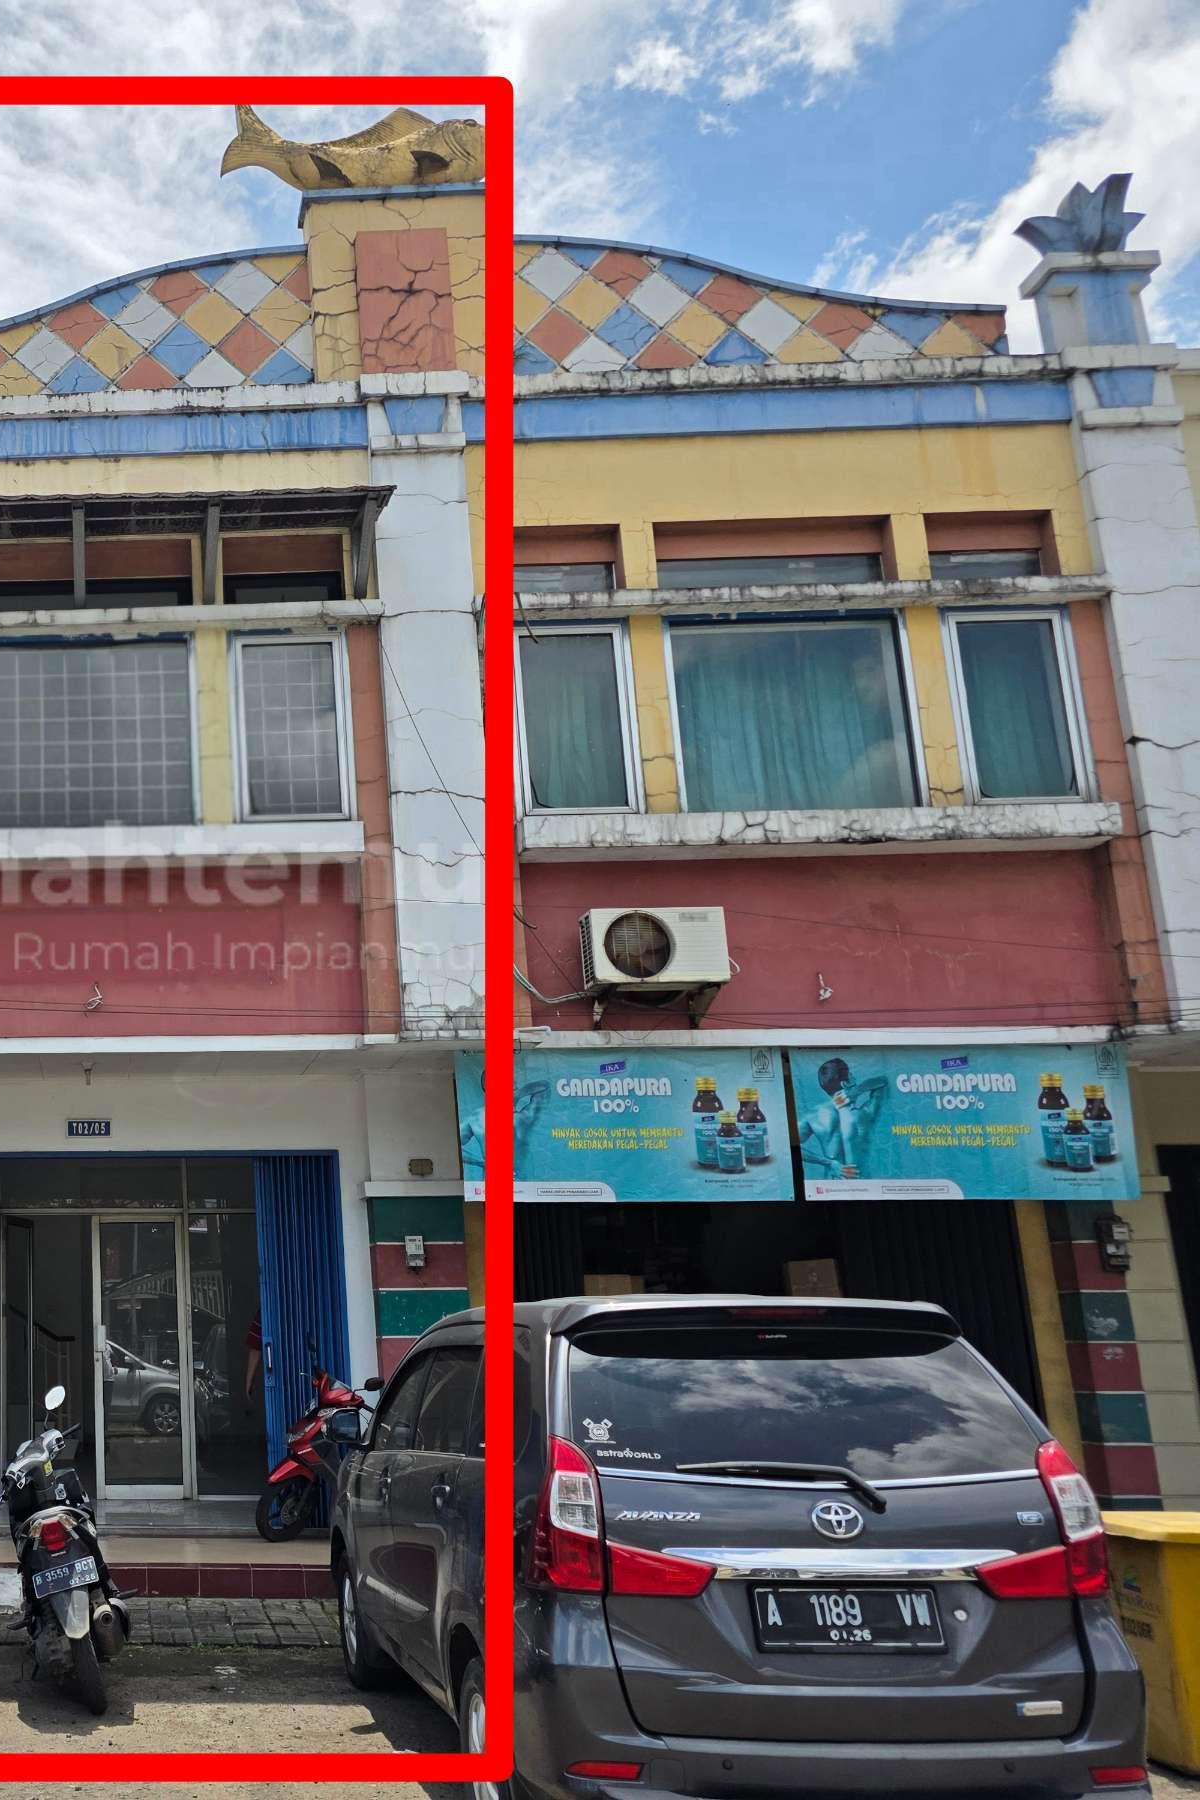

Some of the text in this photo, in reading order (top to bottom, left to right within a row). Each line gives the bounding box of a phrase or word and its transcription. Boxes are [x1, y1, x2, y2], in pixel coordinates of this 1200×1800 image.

[556, 1077, 672, 1097] GANDAPURA
[896, 1073, 1017, 1093] GANDAPURA
[593, 1099, 640, 1113] 100%
[936, 1095, 985, 1110] 100%
[72, 1122, 106, 1134] T02/05
[552, 1127, 683, 1139] MINYAK GOSOK UNTUK MEMBANTU
[892, 1124, 922, 1135] MINYAK
[926, 1124, 951, 1135] GOSOK
[955, 1124, 983, 1135] UNTUK
[568, 1139, 668, 1150] MEREDAKAN PEGAL-PEGAL
[911, 1136, 1017, 1147] MEREDAKAN PEGAL-PEGAL
[614, 1510, 701, 1521] AVANZA
[45, 1567, 70, 1582] 3559
[74, 1560, 94, 1573] BCT
[767, 1594, 783, 1626] A
[809, 1594, 863, 1626] 1189
